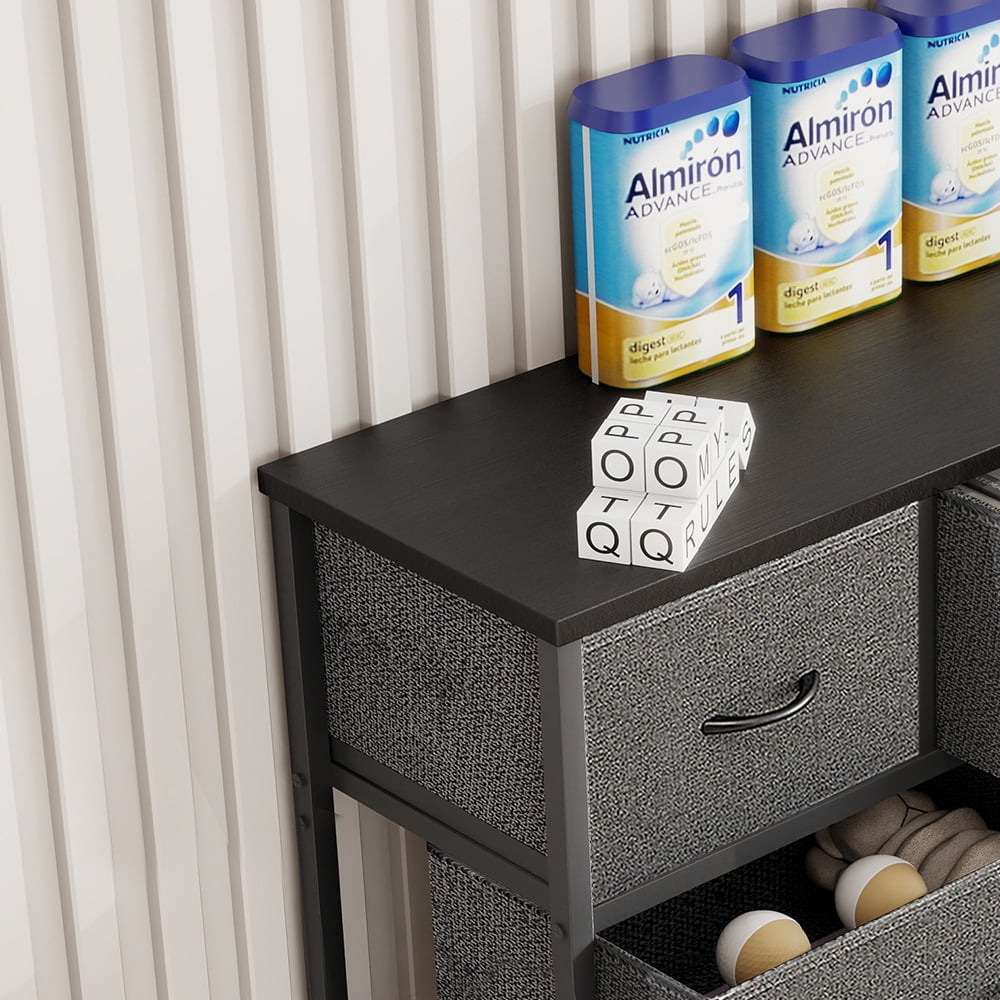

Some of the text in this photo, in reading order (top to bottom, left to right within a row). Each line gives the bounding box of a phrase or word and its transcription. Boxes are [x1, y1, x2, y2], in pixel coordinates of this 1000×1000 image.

[927, 31, 970, 48] NUTRICIA
[782, 77, 827, 95] NUTRICIA
[623, 128, 670, 145] NUTRICIA
[783, 98, 892, 152] Almirón
[782, 131, 864, 168] ADVANCE
[625, 148, 741, 203] Almirón
[625, 183, 711, 220] ADVANCE
[878, 229, 892, 271] 1
[925, 232, 959, 249] digest
[728, 282, 743, 324] 1
[784, 282, 818, 300] digest
[629, 337, 665, 354] digest
